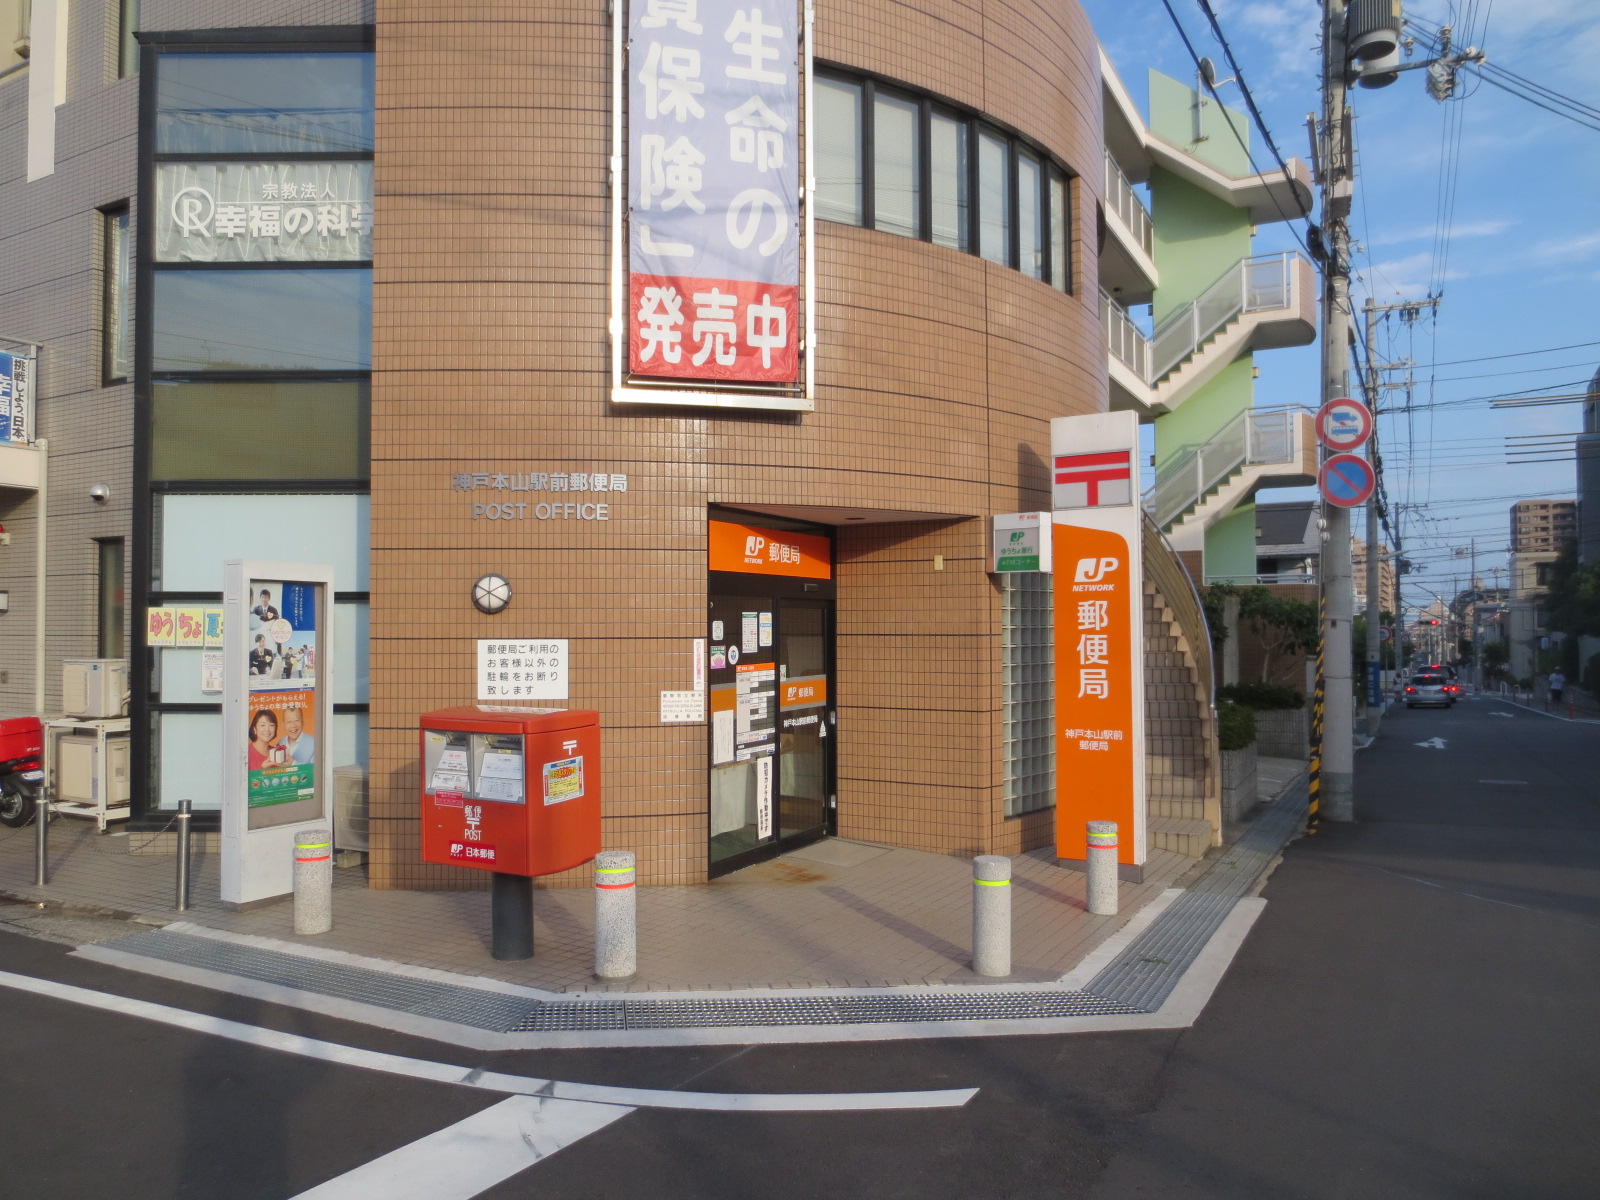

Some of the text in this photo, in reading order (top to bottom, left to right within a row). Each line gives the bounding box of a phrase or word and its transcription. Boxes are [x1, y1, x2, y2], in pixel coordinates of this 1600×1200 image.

[262, 182, 336, 199] 宗教法人
[637, 285, 787, 369] 発売中
[452, 472, 628, 492] 神戸本山駅前郵便局
[472, 503, 608, 521] POST OFFICE
[768, 543, 800, 565] 郵便局
[744, 557, 763, 565] NETWORK
[1072, 584, 1115, 592] NETWORK
[206, 613, 223, 638] 夏
[487, 644, 559, 654] 郵便局ご利用の
[1076, 600, 1109, 699] 郵便局
[487, 658, 559, 668] お客様以外の
[487, 671, 558, 682] 駐輪をお断り
[487, 685, 534, 695] 致します
[1065, 729, 1123, 740] 神戸本山駅前
[1079, 740, 1109, 751] 郵便局
[464, 805, 482, 818] 郵便
[464, 829, 482, 841] POST
[465, 846, 496, 860] 日本郵便
